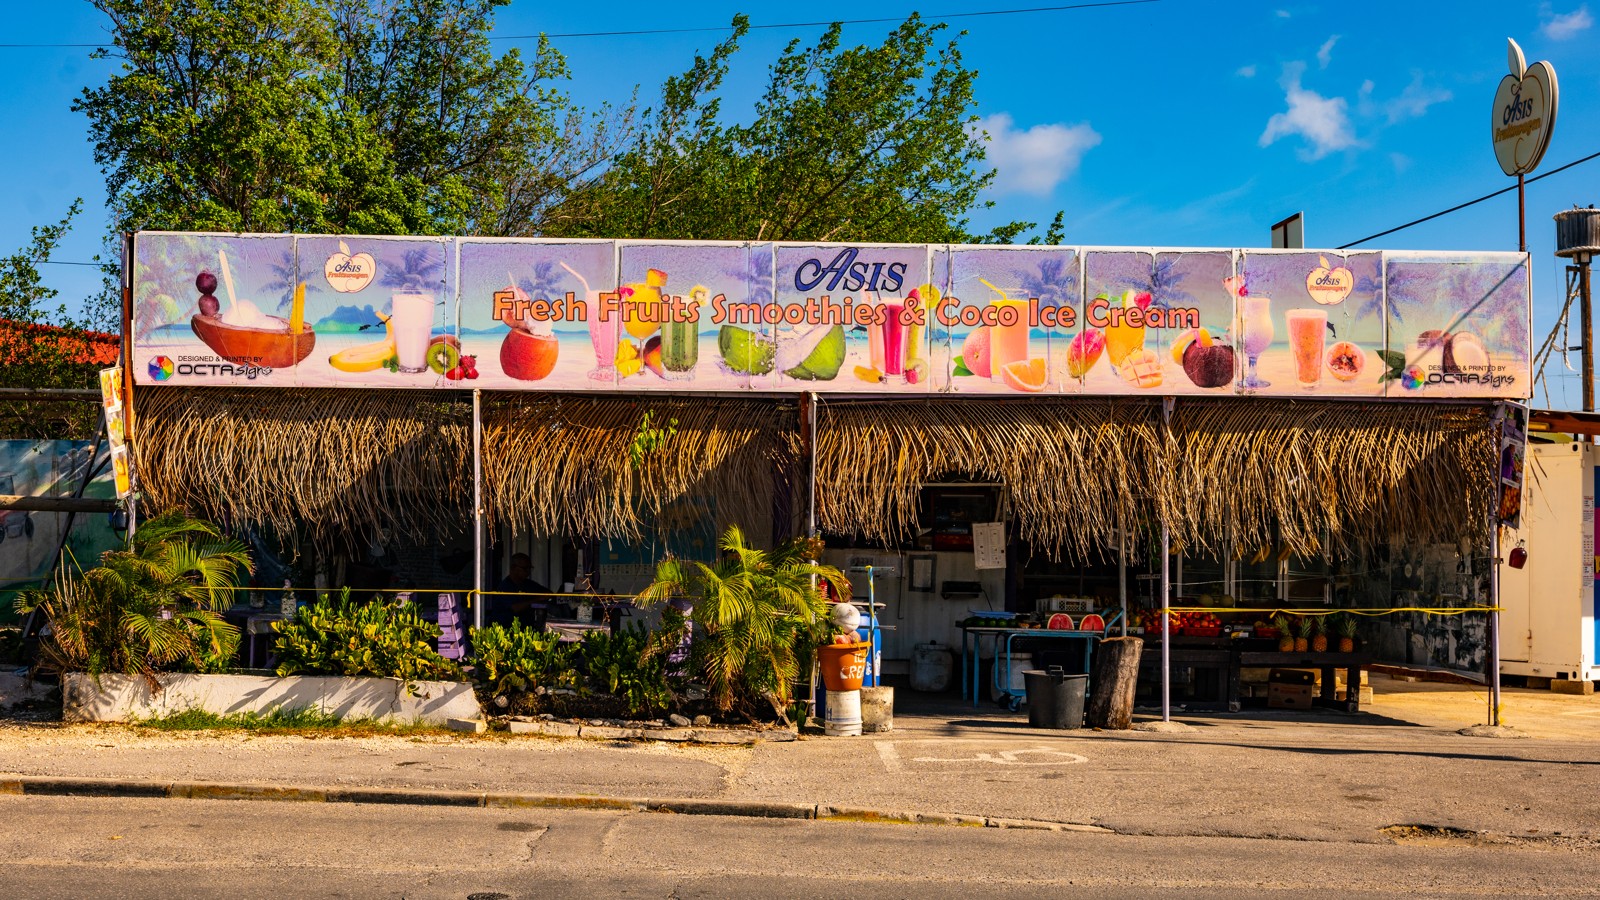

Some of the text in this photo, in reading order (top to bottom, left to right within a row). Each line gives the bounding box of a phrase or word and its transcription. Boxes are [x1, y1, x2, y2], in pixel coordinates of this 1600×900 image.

[492, 290, 1200, 329] Fresh Fruits Smoothies & Coco Ice Cream
